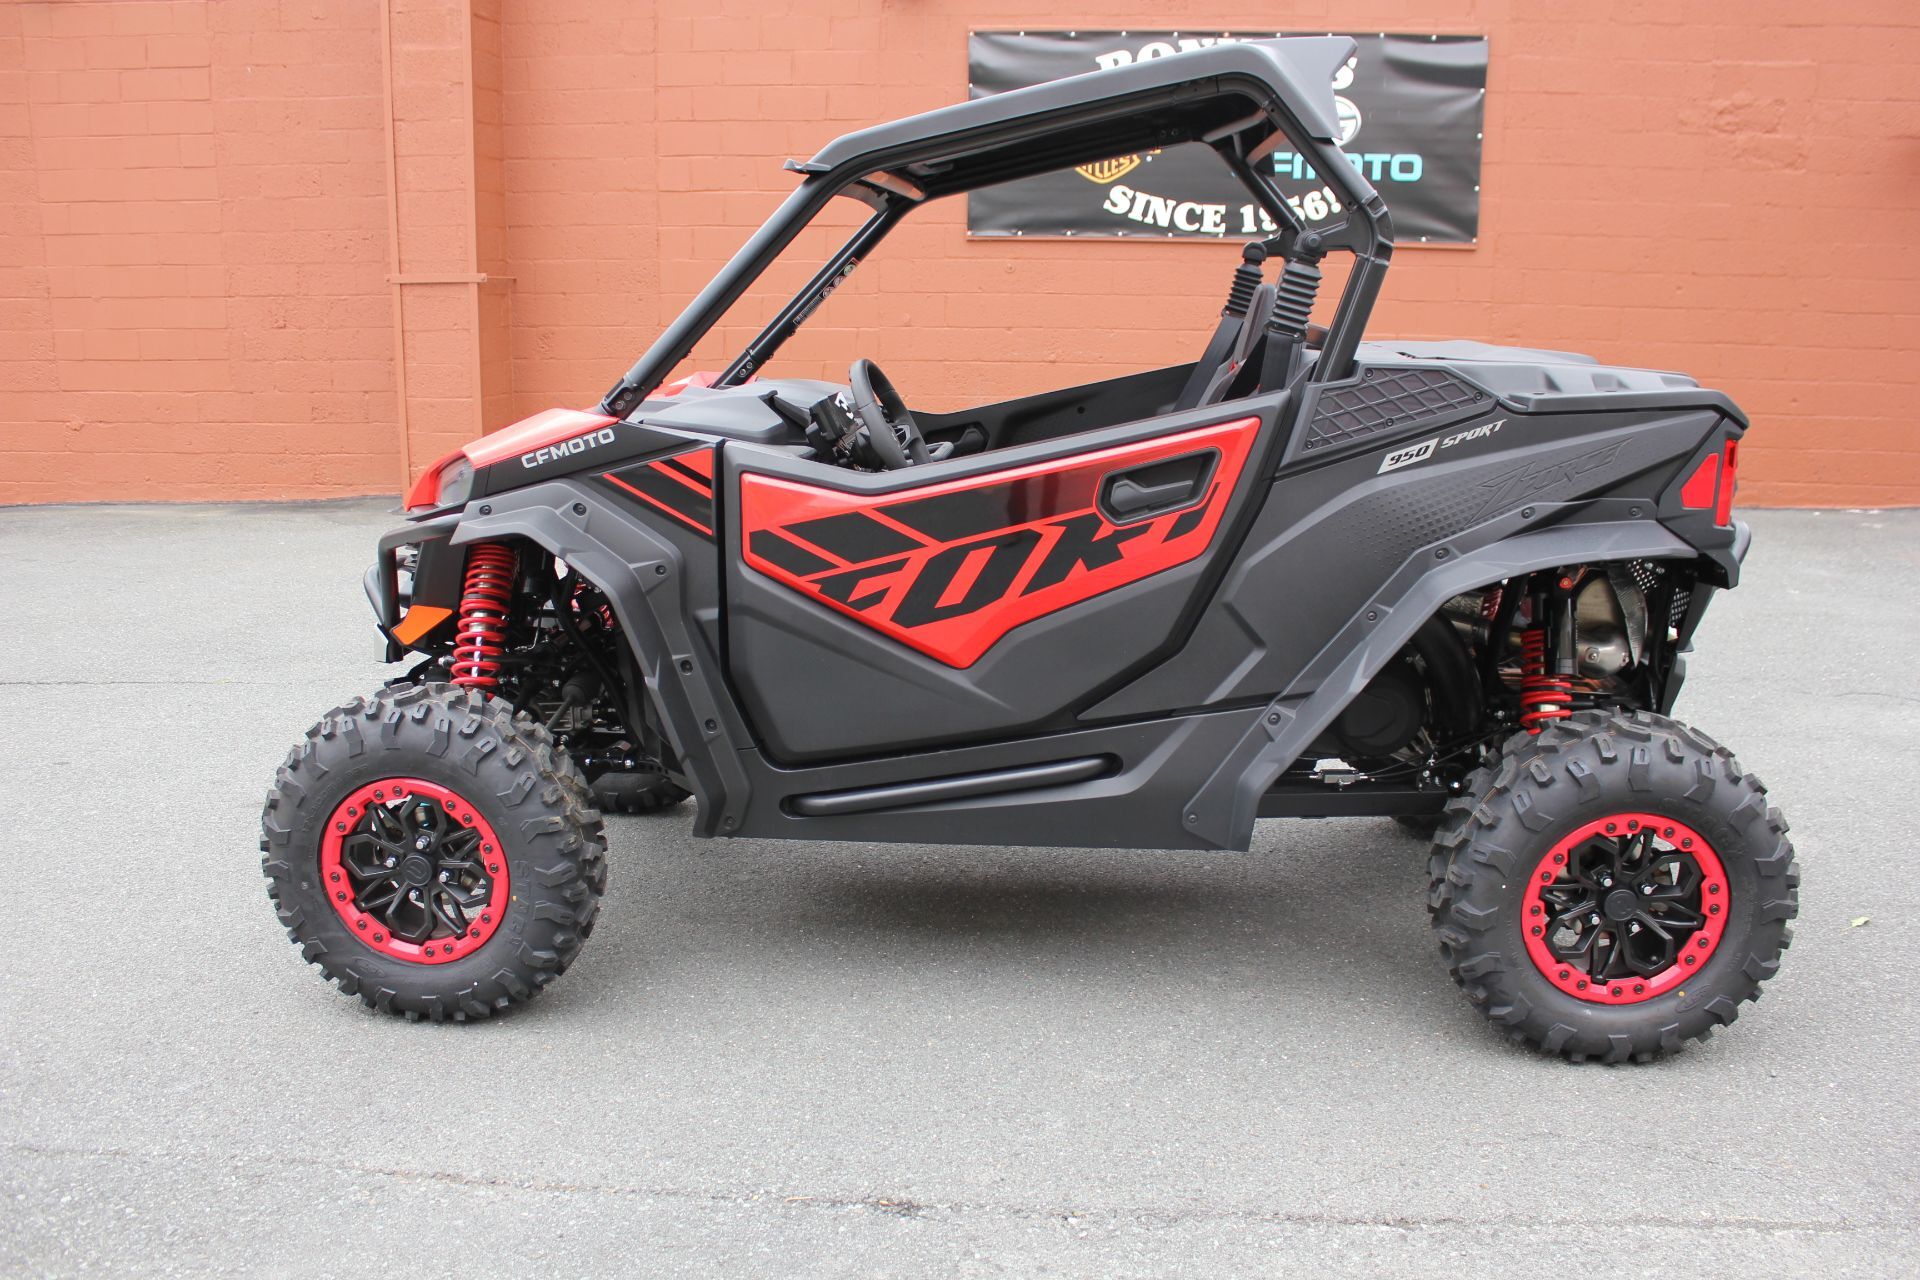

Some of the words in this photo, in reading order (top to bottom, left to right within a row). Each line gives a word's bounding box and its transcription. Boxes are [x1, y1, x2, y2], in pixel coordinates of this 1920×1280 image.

[1103, 184, 1226, 233] SINCE
[521, 428, 615, 469] CFMOTO
[1388, 444, 1431, 466] 950
[1441, 419, 1508, 449] SPORT
